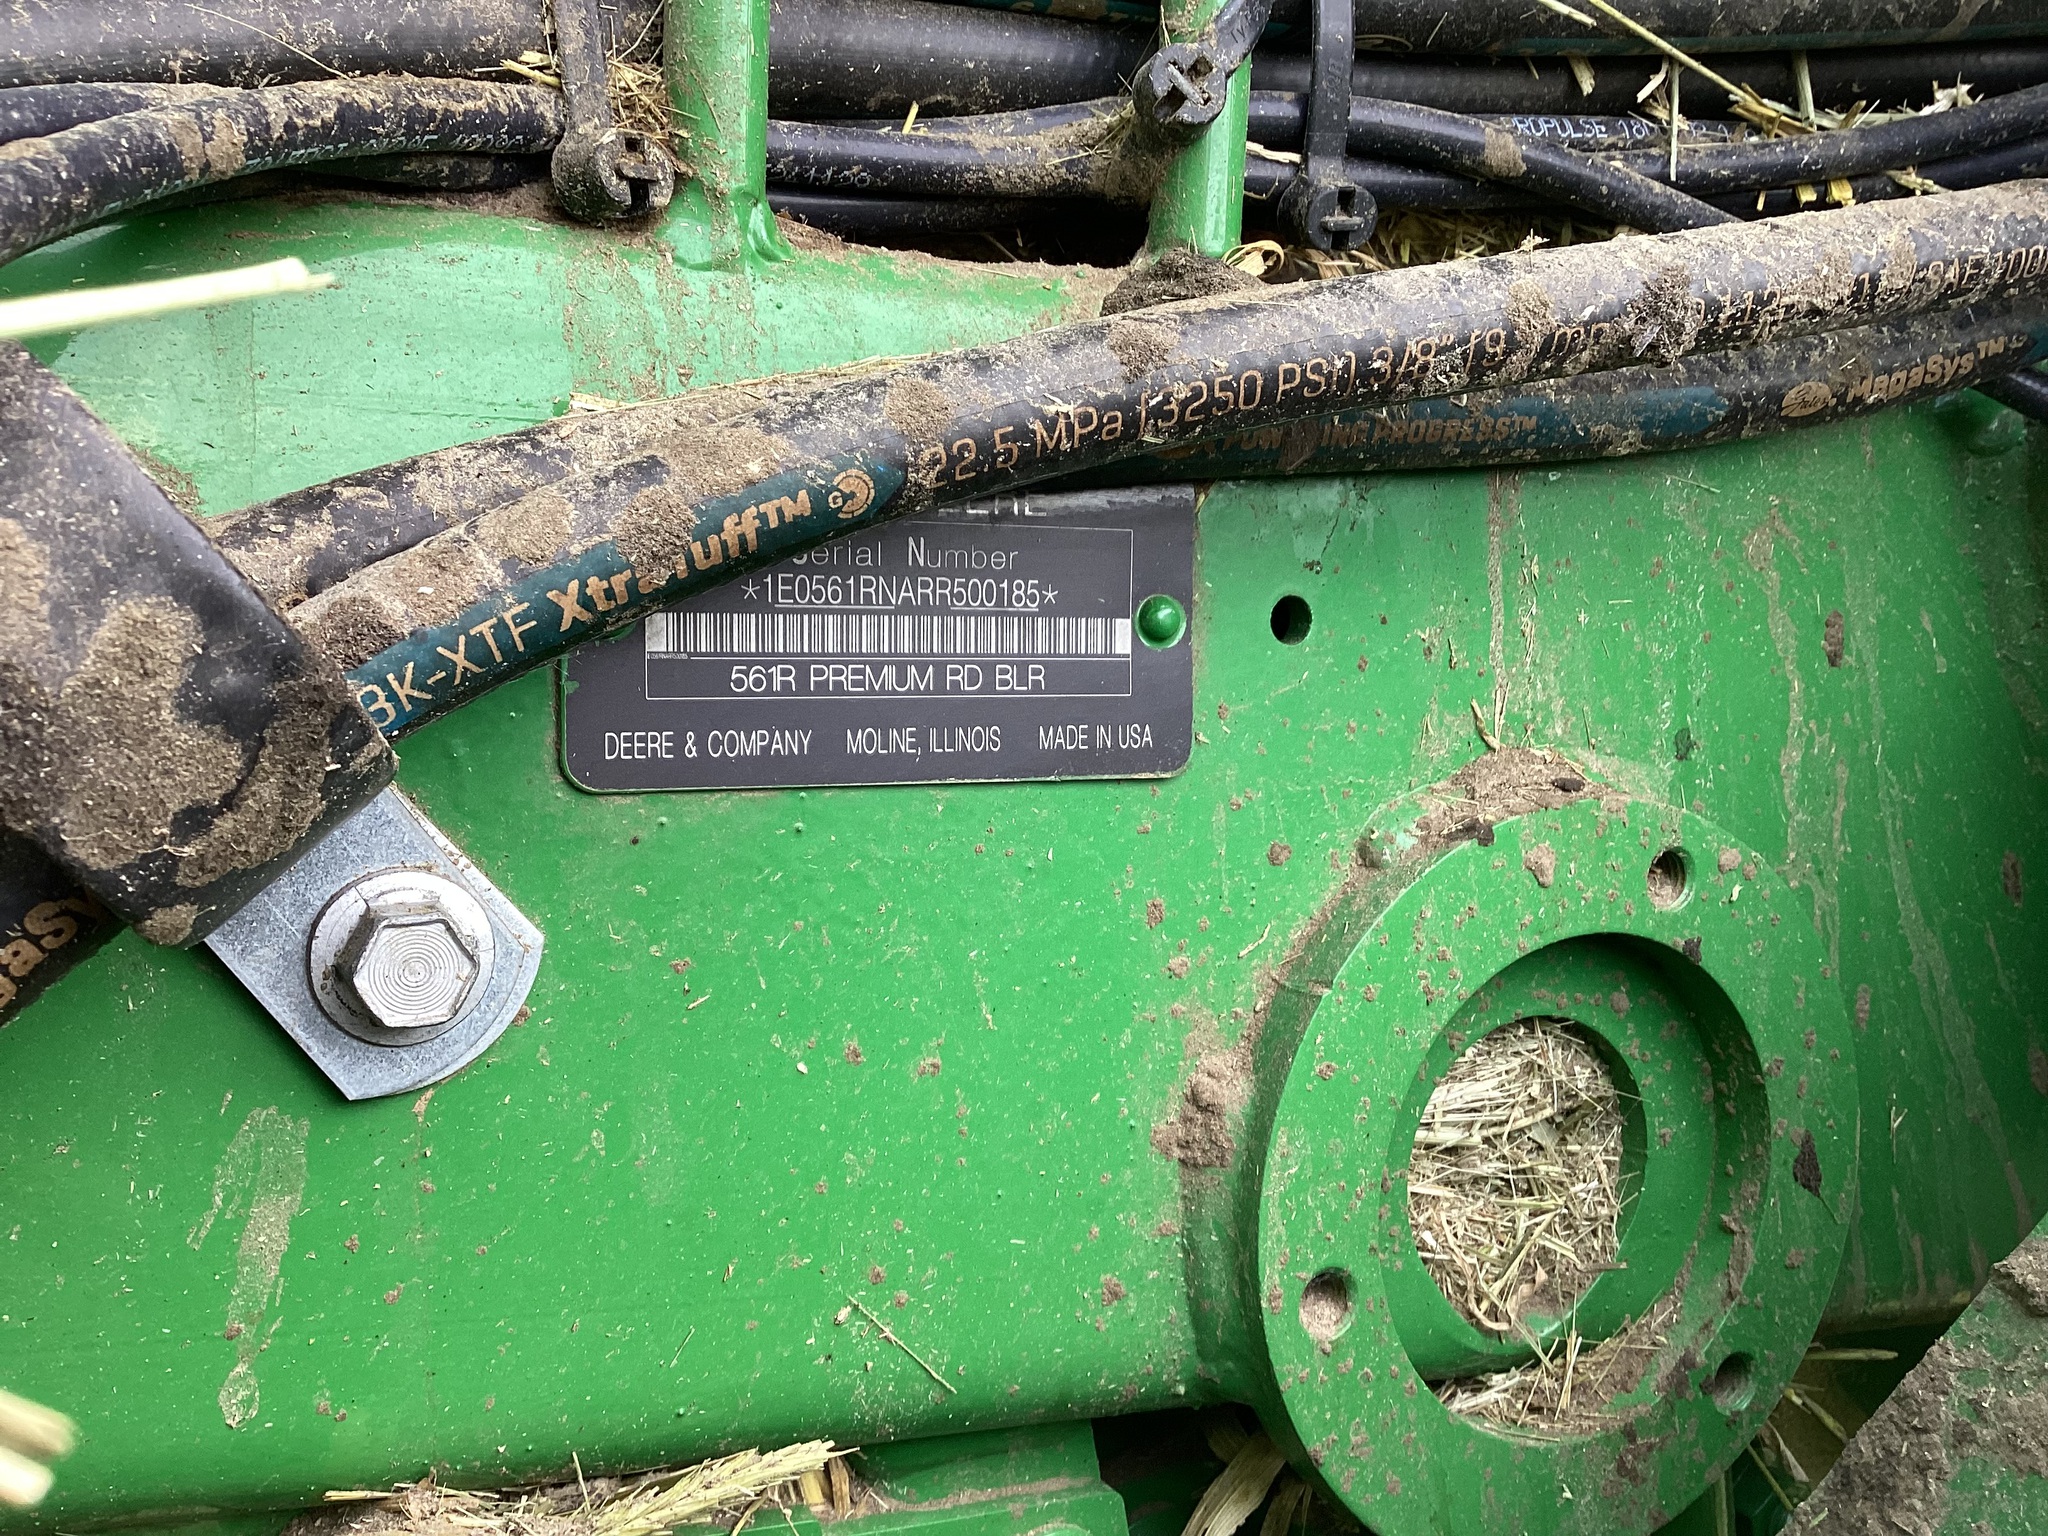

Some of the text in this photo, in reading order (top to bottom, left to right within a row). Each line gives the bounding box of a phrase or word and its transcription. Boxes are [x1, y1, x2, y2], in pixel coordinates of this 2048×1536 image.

[1033, 404, 1124, 458] MPa
[908, 536, 1019, 569] Number
[730, 664, 1046, 693] 561R PREMIUM RD BLR
[604, 723, 1153, 760] DEERE & COMPANY MOLINE, ILLINOIS MADE IN USA
